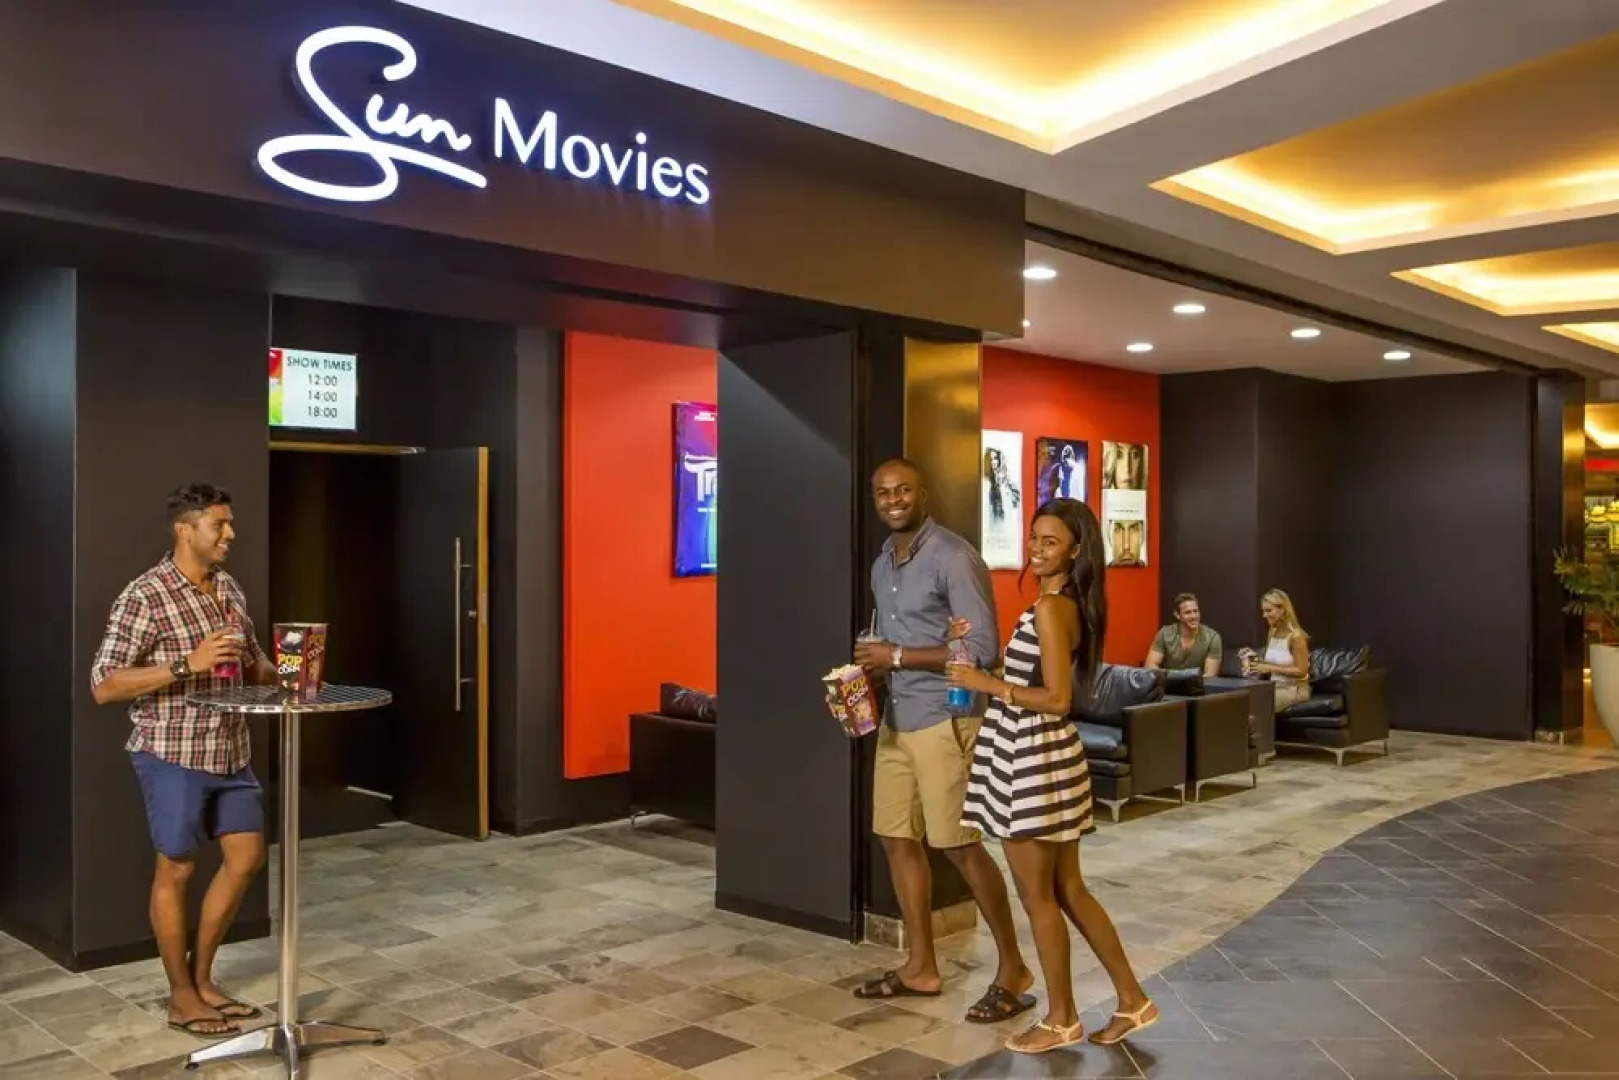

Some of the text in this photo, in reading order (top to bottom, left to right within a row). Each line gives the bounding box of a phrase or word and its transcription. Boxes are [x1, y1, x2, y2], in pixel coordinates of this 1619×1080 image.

[257, 25, 710, 204] Sun Movies
[286, 356, 352, 371] SHOW TIMES
[308, 374, 338, 386] 12:00
[308, 390, 338, 402] 14:00
[308, 406, 338, 418] 18:00
[277, 653, 304, 666] POP
[840, 675, 867, 697] POP
